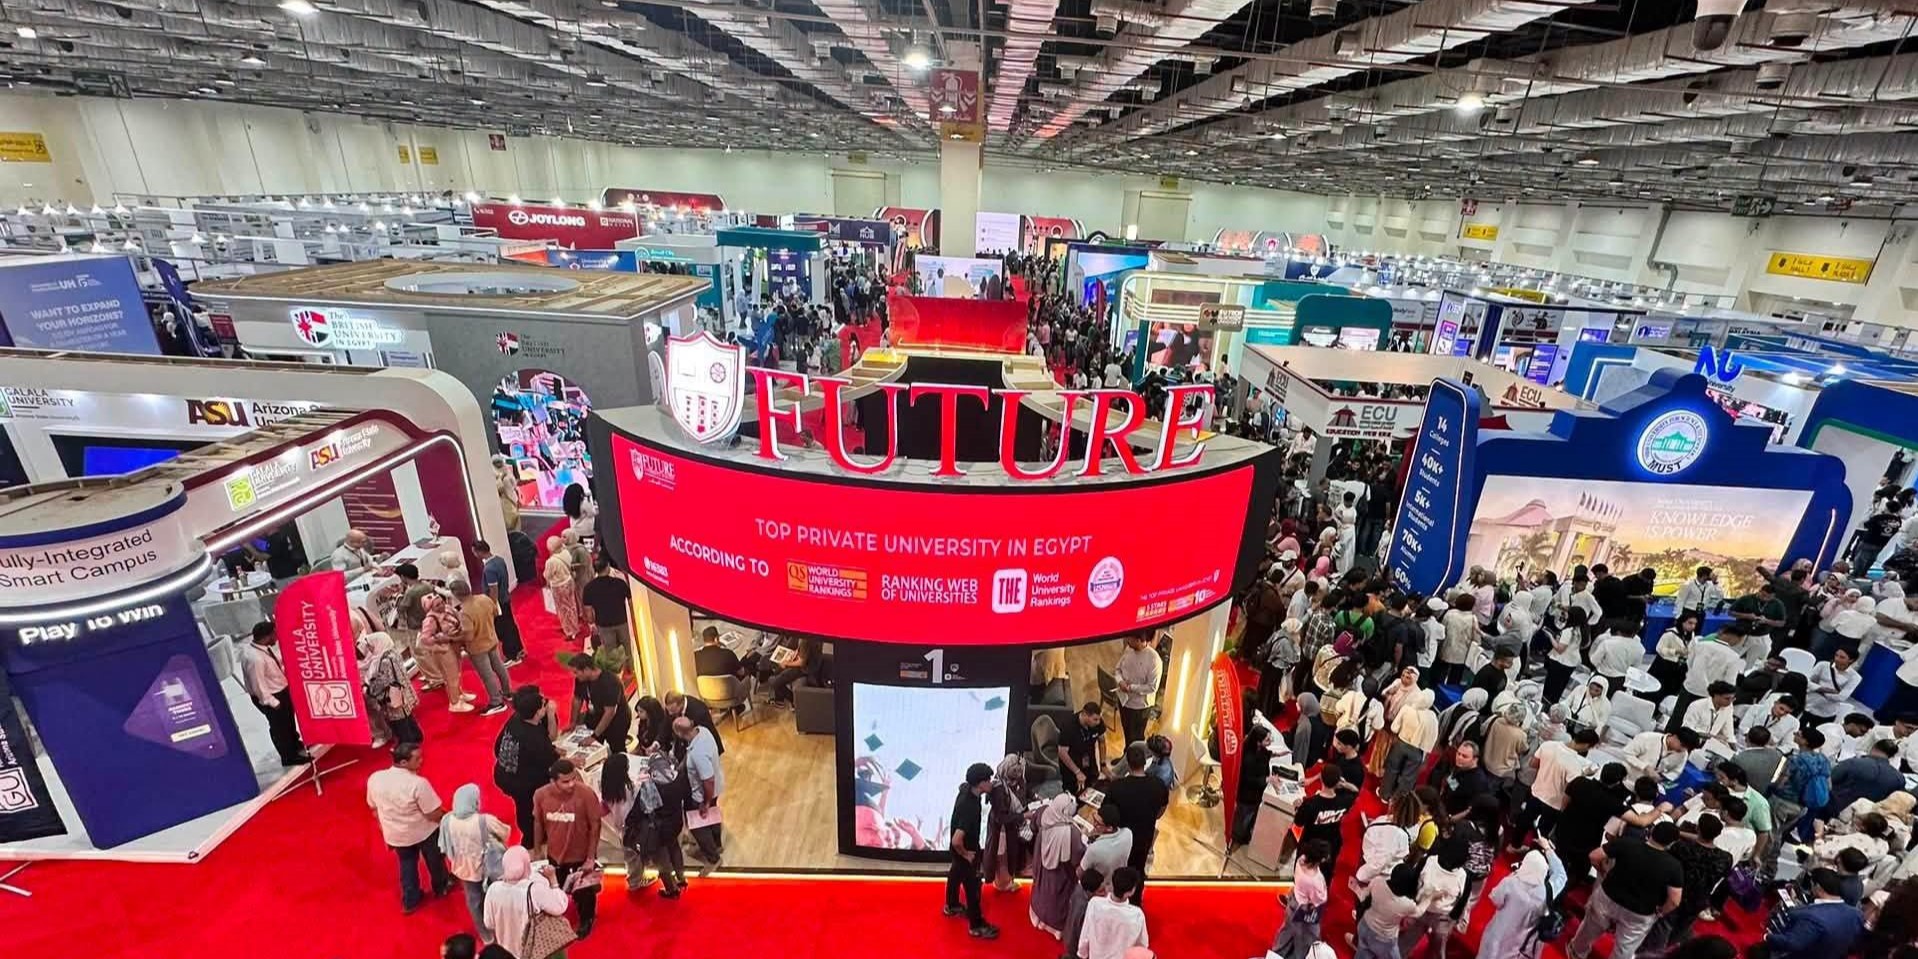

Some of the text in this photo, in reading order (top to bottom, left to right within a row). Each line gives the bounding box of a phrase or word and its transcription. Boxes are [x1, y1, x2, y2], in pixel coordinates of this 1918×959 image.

[528, 213, 586, 226] JOYLONG
[31, 300, 120, 319] WANT TO EXPAND
[329, 311, 344, 319] The
[36, 320, 66, 332] YOUR
[68, 311, 124, 328] HORIZONS?
[334, 330, 397, 341] UNIVERSITY
[1275, 371, 1289, 389] ECU
[4, 387, 48, 397] GALALA
[7, 396, 74, 407] UNIVERSITY
[1520, 385, 1542, 403] ECU
[184, 399, 250, 427] ASU
[253, 402, 309, 416] Arizona
[1361, 405, 1398, 421] ECU
[745, 365, 1215, 481] FUTURE
[1326, 428, 1361, 437] EDUCATION
[1438, 416, 1447, 433] 14
[1429, 430, 1449, 447] Colleges
[311, 443, 340, 469] ASU
[643, 453, 675, 476] FUTURE
[1422, 453, 1444, 474] 40K+
[1648, 460, 1681, 473] MUST
[1419, 468, 1440, 487] Students
[1414, 490, 1430, 509] 5K+
[1406, 500, 1435, 527] International
[1408, 511, 1427, 531] Students
[1650, 510, 1755, 529] KNOWLEDGE
[755, 518, 1093, 557] TOP PRIVATE UNIVERSITY IN EGYPT
[1402, 529, 1422, 553] 70K+
[1644, 525, 1719, 541] IS POWER
[0, 529, 153, 571] ully-Integrated
[669, 534, 769, 577] ACCORDING TO
[70, 549, 157, 581] Campus
[788, 564, 806, 583] QS
[807, 566, 839, 577] WORLD
[0, 571, 64, 588] Smart
[808, 575, 857, 589] UNIVERSITY
[881, 574, 978, 592] RANKING WEB
[1032, 572, 1059, 583] World
[1395, 567, 1411, 590] 60%
[808, 584, 853, 598] RANKINGS
[881, 589, 978, 604] OF UNIVERSITIES
[998, 577, 1023, 605] THE
[1031, 583, 1076, 595] University
[1030, 595, 1071, 607] Rankings
[19, 622, 78, 645] Play
[301, 600, 326, 680] UNIVERSITY
[292, 628, 313, 679] GALALA
[923, 649, 944, 683] 1
[331, 685, 350, 713] GU
